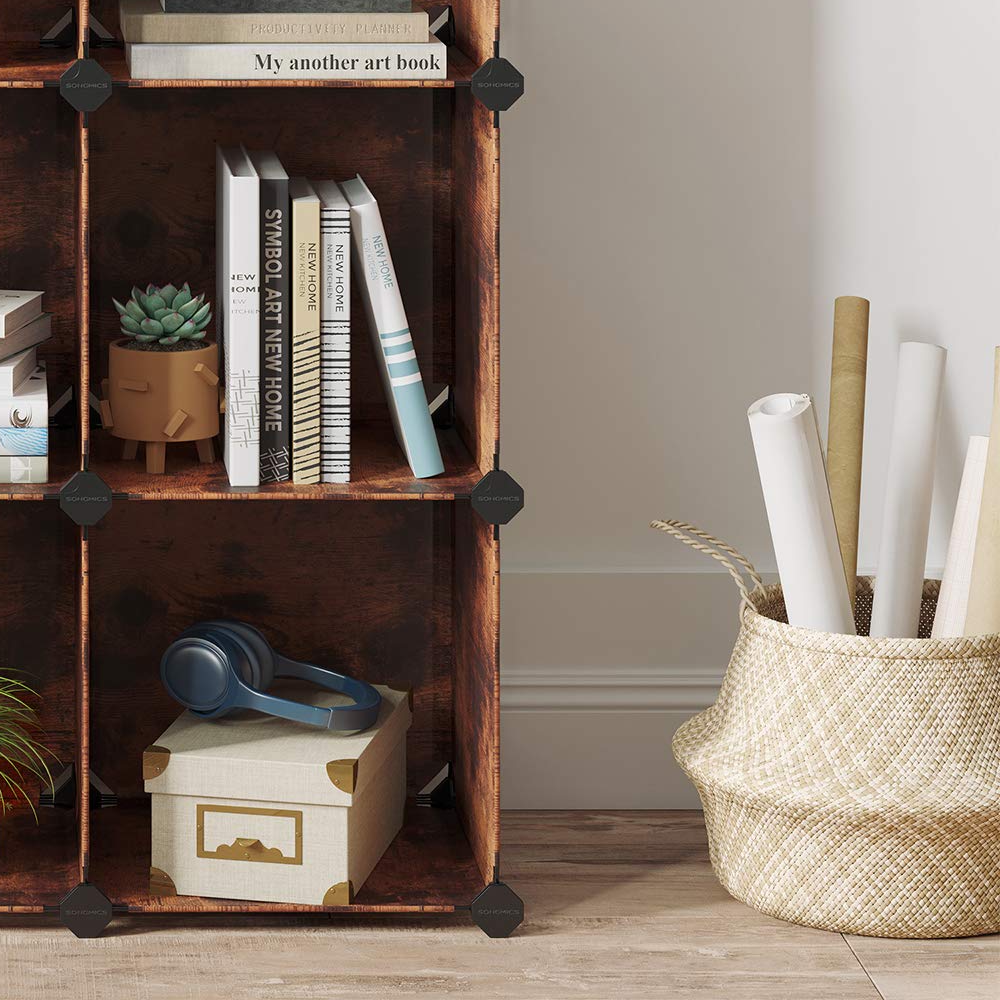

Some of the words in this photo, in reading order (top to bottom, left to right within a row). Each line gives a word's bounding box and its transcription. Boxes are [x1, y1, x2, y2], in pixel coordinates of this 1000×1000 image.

[250, 23, 346, 35] PRODUCTIVITY
[356, 23, 412, 34] PLANNER
[254, 54, 284, 75] My
[289, 53, 359, 71] another
[364, 55, 391, 71] art
[396, 53, 441, 71] book
[264, 208, 283, 284] SYMBOL
[307, 242, 317, 272] NEW
[326, 243, 334, 263] NEW
[335, 244, 344, 273] NEW
[373, 235, 386, 258] NEW
[326, 264, 334, 299] KITCHEN
[378, 259, 394, 289] HOME
[264, 287, 283, 324] ART
[307, 274, 317, 312] HOME
[335, 276, 344, 313] HOME
[264, 329, 283, 373] NEW
[264, 377, 283, 432] HOME
